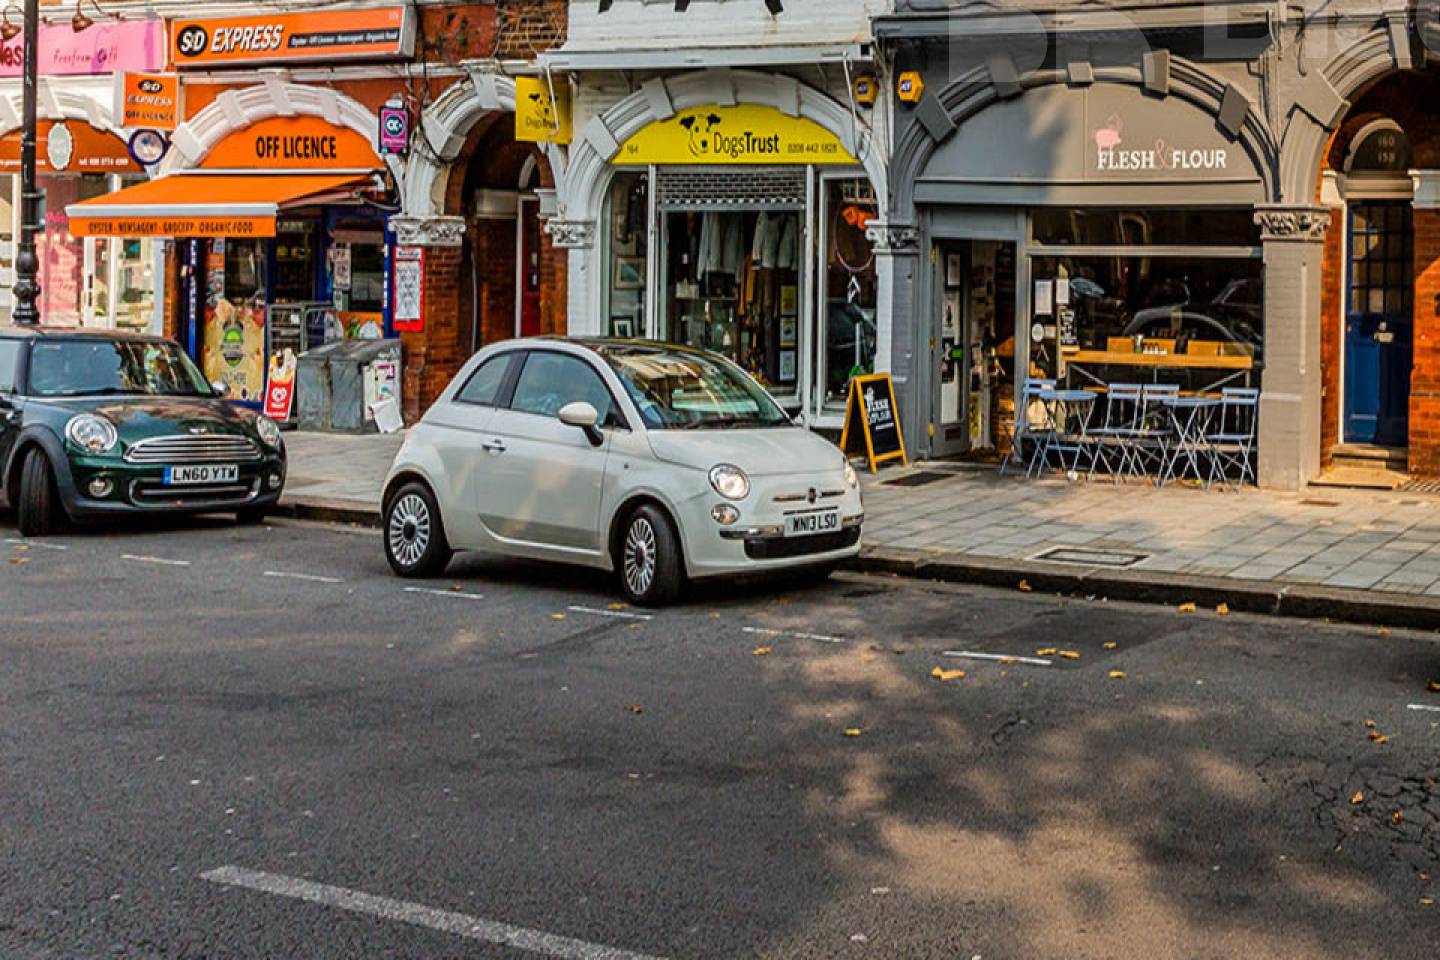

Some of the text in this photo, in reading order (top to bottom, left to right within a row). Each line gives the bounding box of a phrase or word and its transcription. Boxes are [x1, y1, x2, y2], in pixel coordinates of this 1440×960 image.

[211, 24, 283, 52] EXPRESS
[256, 136, 337, 159] OFF LICENCE
[713, 132, 779, 159] DogsTrust
[1098, 150, 1155, 169] FLESH
[1172, 150, 1227, 169] FLOUR
[89, 222, 113, 234] OYSTER
[118, 222, 157, 234] NEWSAGENT
[200, 222, 231, 234] ORGANIC
[233, 222, 253, 234] FOOD
